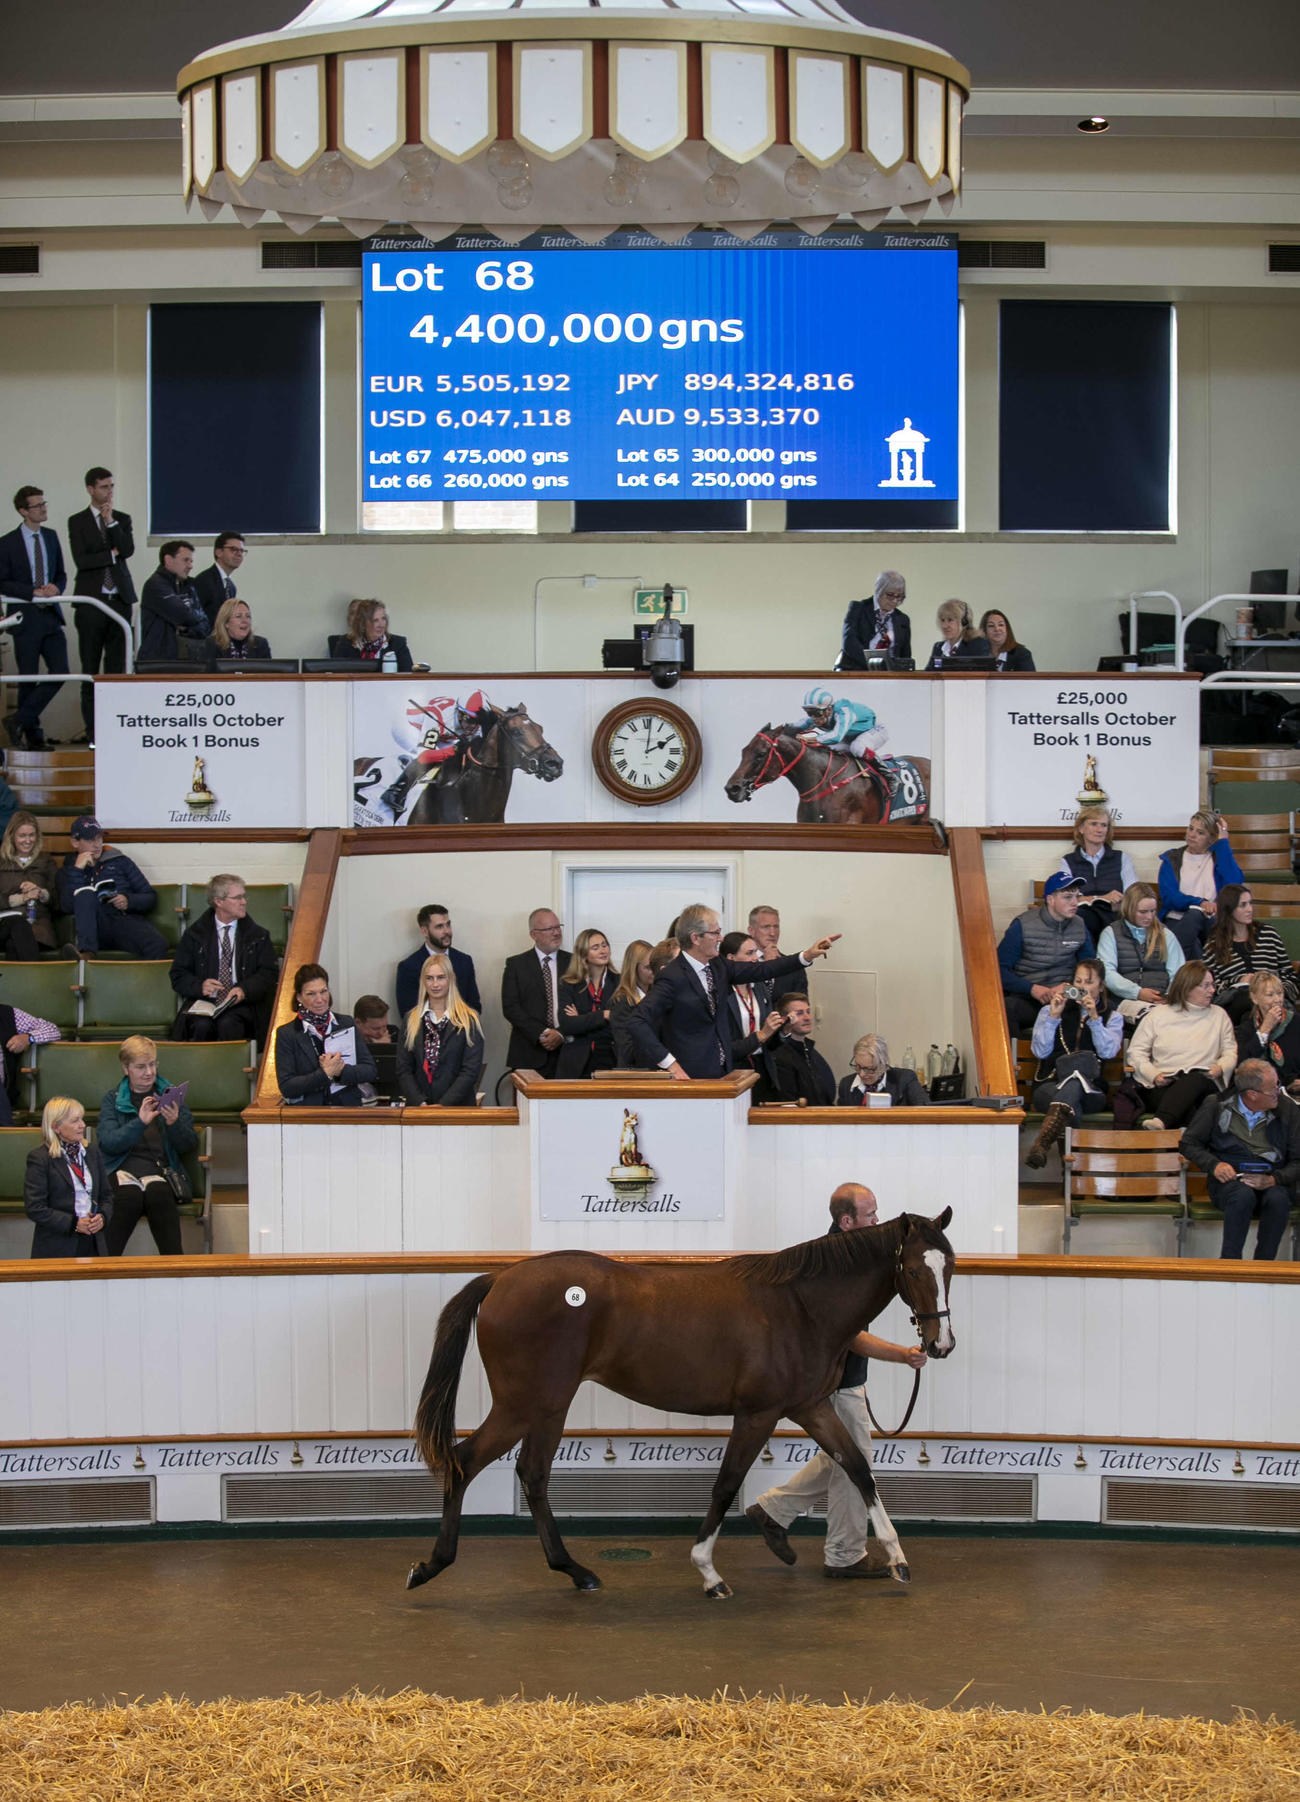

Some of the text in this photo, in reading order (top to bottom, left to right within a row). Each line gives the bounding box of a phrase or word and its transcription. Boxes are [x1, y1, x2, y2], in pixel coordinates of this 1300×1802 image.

[370, 237, 435, 249] Tattersalls
[712, 234, 778, 247] Tattersalls
[797, 234, 864, 247] Tattersalls
[883, 234, 950, 248] Tattersalls
[371, 260, 535, 292] Lot 68
[409, 312, 745, 350] 4,400,000 gns
[370, 373, 571, 394] EUR 5,505,192
[615, 372, 855, 395] JPY 894,324,816
[370, 408, 572, 429] USD 6,047,118
[615, 407, 820, 428] AUD 9,533,370
[369, 448, 569, 466] Lot 67 475,000 gns
[616, 447, 818, 465] Lot 65 300,000 gns
[369, 472, 570, 490] Lot 66 260,000 gns
[616, 471, 818, 489] Lot 64 250,000 gns
[165, 693, 236, 709] £25,000
[1057, 691, 1128, 707] £25,000
[116, 712, 285, 728] Tattersalls October
[1007, 711, 1177, 726] Tattersalls October
[142, 734, 260, 748] Book 1 Bonus
[423, 730, 440, 749] 2
[1033, 732, 1152, 747] Book 1 Bonus
[900, 768, 918, 805] 8
[168, 809, 231, 822] Tattersalls
[1059, 807, 1123, 821] Tatlls
[580, 1193, 681, 1213] Tattersalls
[158, 1443, 280, 1468] Tattersalls
[314, 1442, 421, 1465] Tattersal
[628, 1441, 725, 1462] Tattersa
[941, 1445, 1063, 1468] Tattersalls
[0, 1449, 122, 1473] Tattersalls
[1099, 1449, 1221, 1473] Tattersalls
